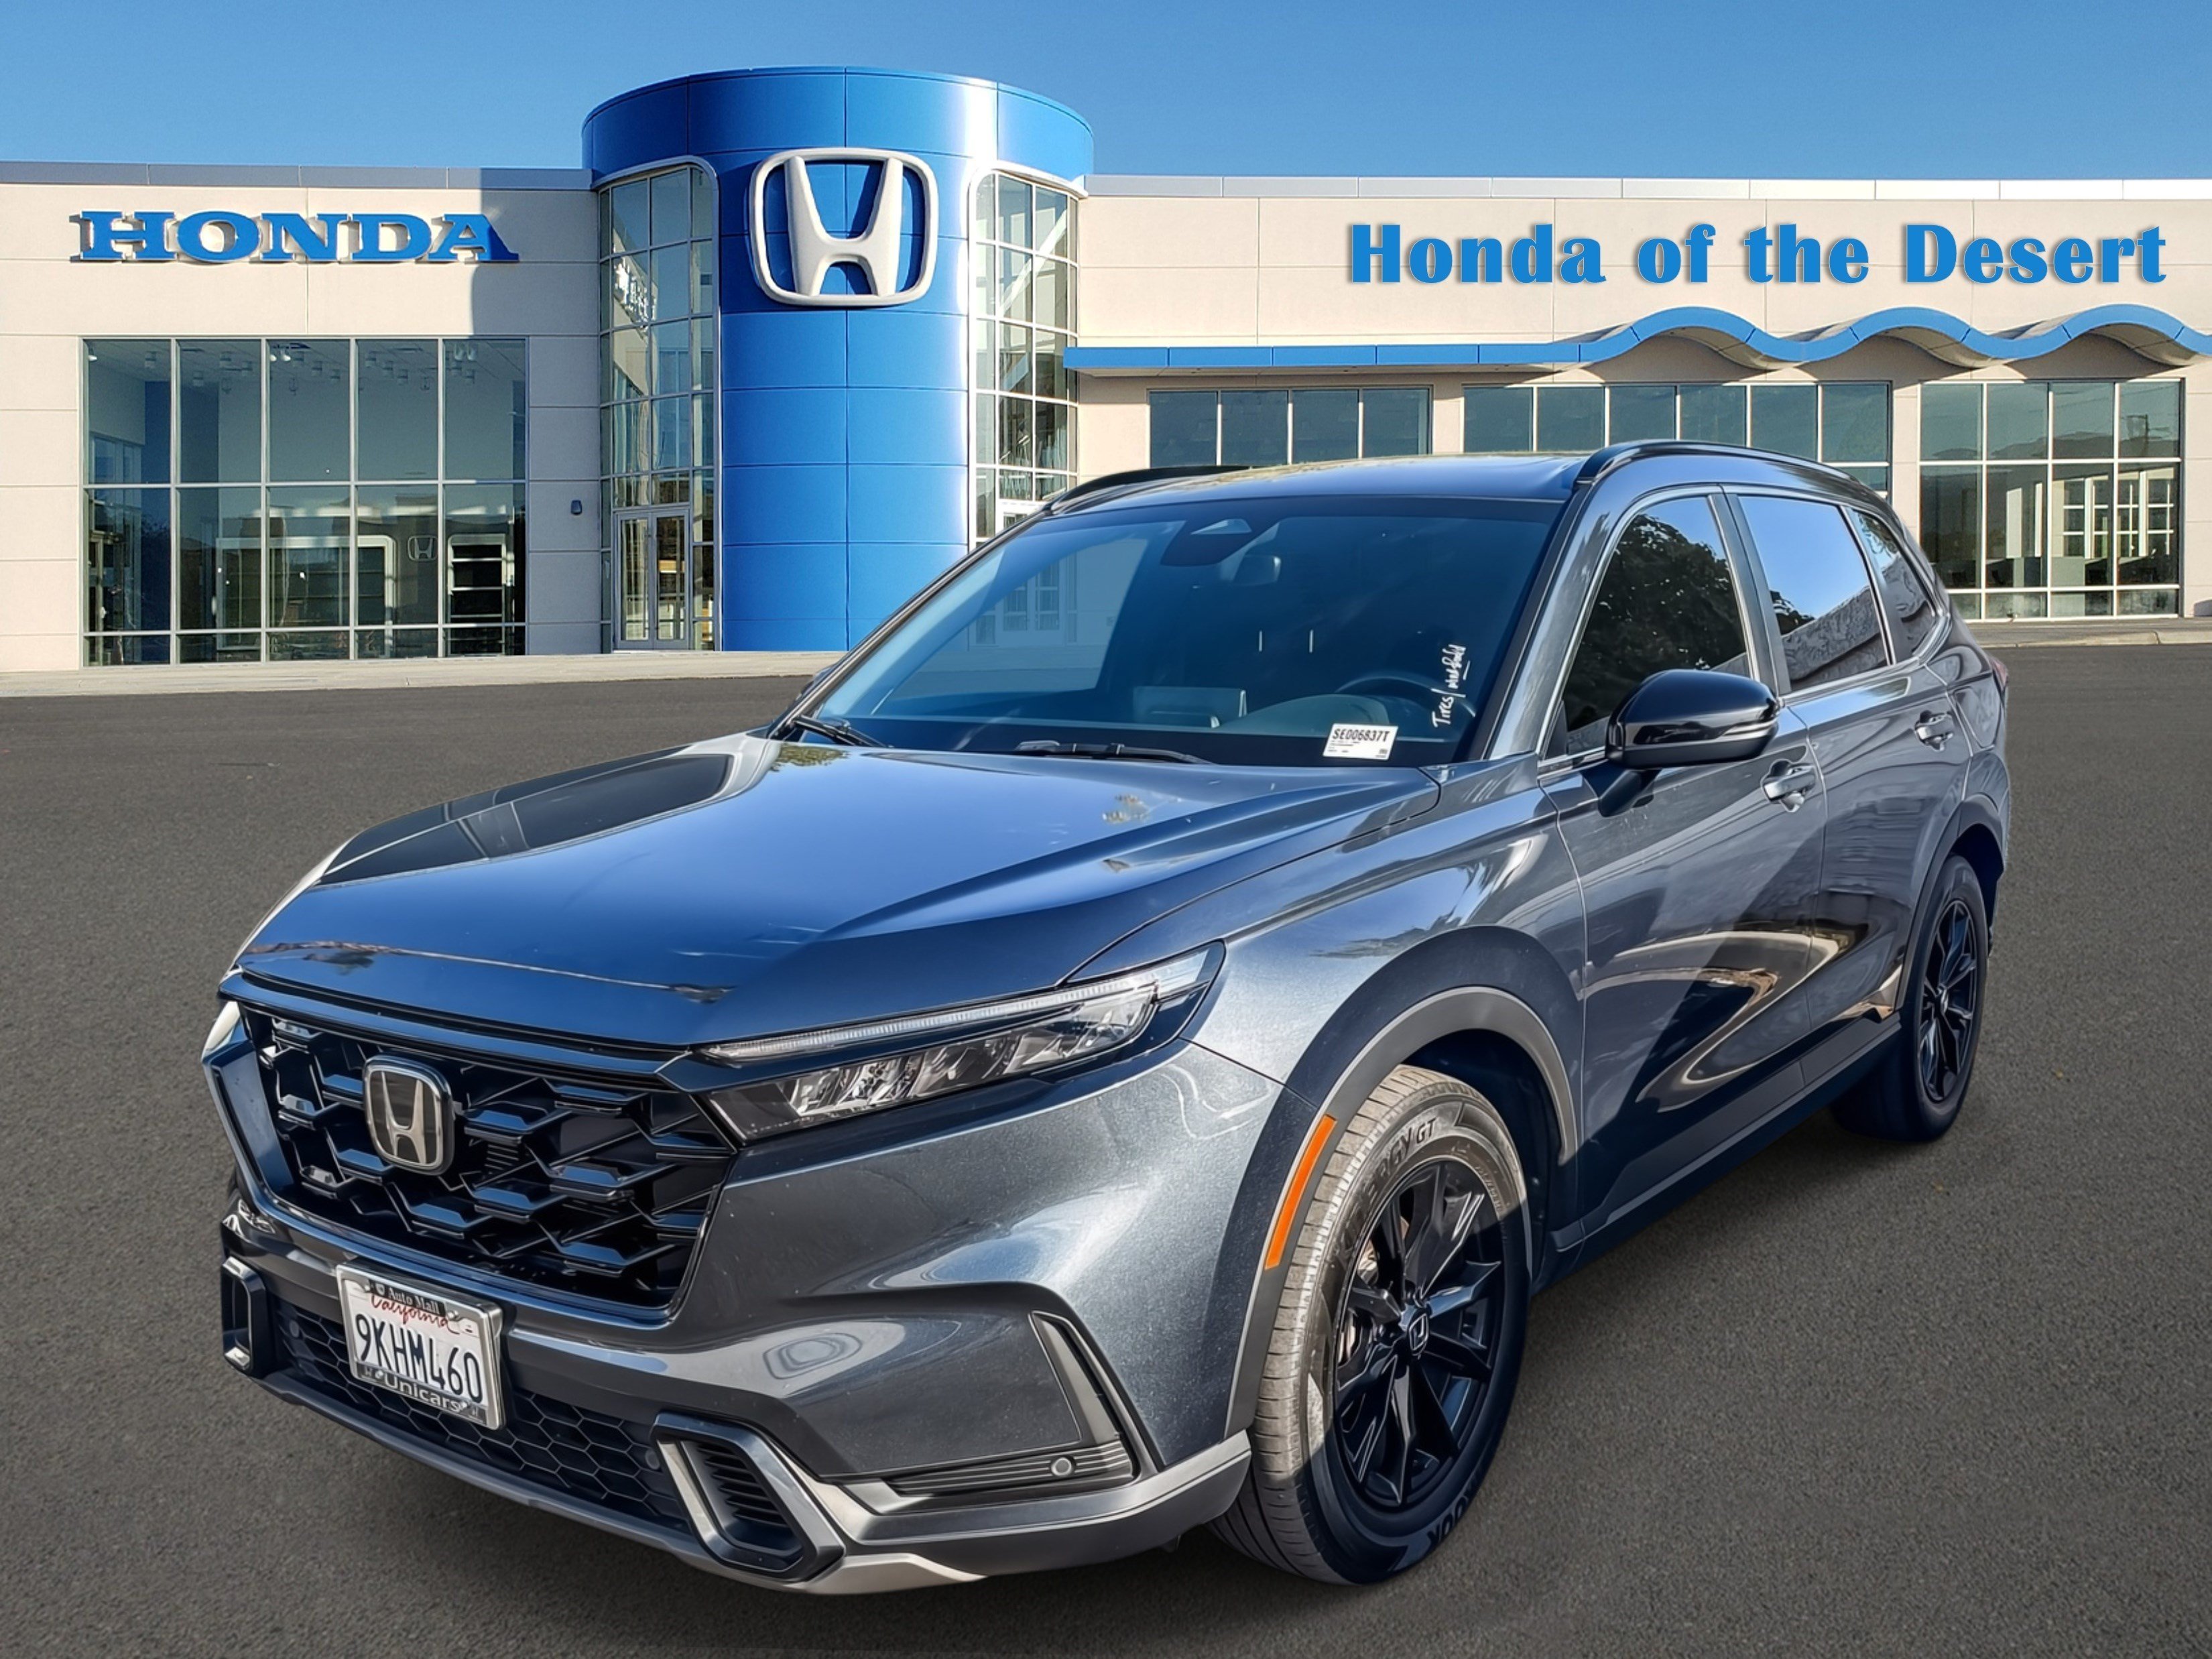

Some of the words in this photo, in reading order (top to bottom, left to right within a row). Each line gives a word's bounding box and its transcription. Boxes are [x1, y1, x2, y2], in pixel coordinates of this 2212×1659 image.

[80, 210, 520, 262] HONDA
[1351, 223, 1607, 284] Honda
[1638, 223, 1717, 284] of
[1743, 223, 1869, 284] the
[1905, 224, 2166, 284] Desert
[1332, 728, 1392, 743] SE006837T
[1416, 1117, 1436, 1144] GT
[387, 1286, 414, 1306] Auto
[414, 1294, 441, 1315] Mall
[355, 1313, 483, 1404] 9KHM460
[384, 1373, 463, 1413] Unicars
